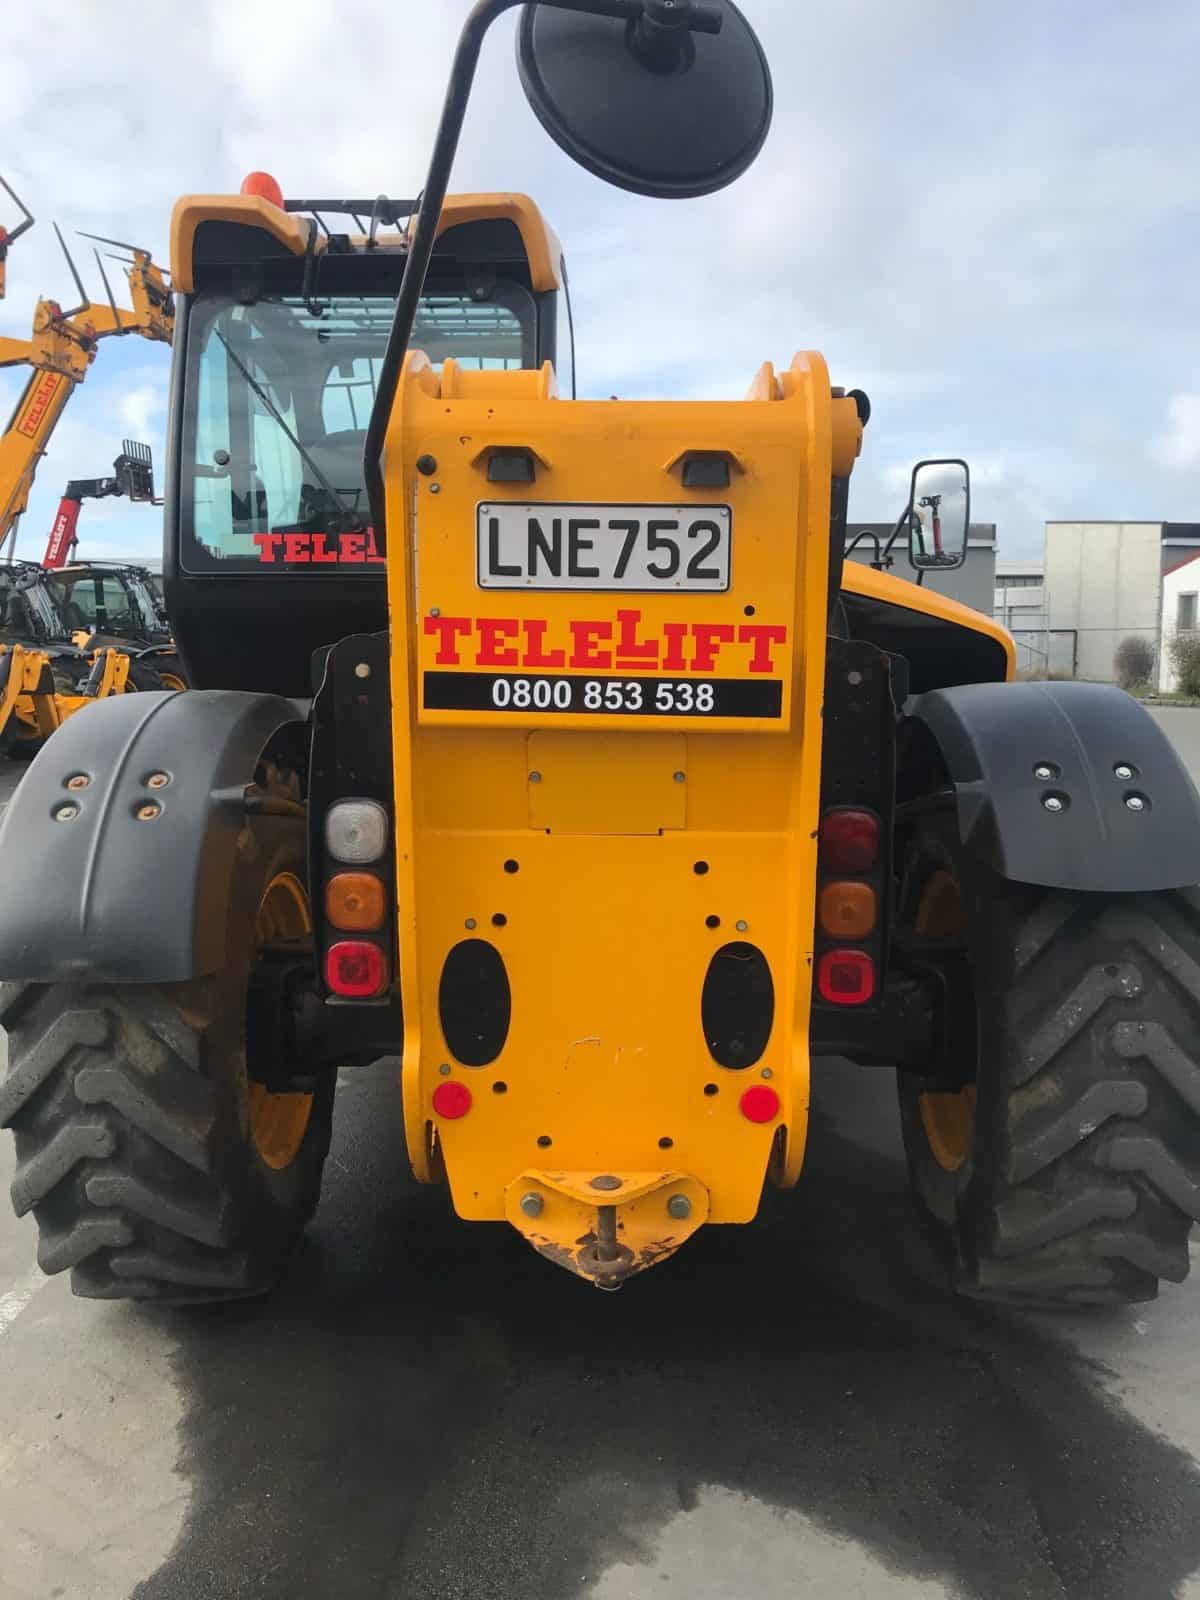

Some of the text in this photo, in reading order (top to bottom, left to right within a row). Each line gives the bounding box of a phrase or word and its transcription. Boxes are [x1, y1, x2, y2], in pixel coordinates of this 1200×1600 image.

[488, 517, 722, 580] LNE752
[423, 608, 787, 674] TELELIFT
[492, 678, 715, 712] 0800 853 538
